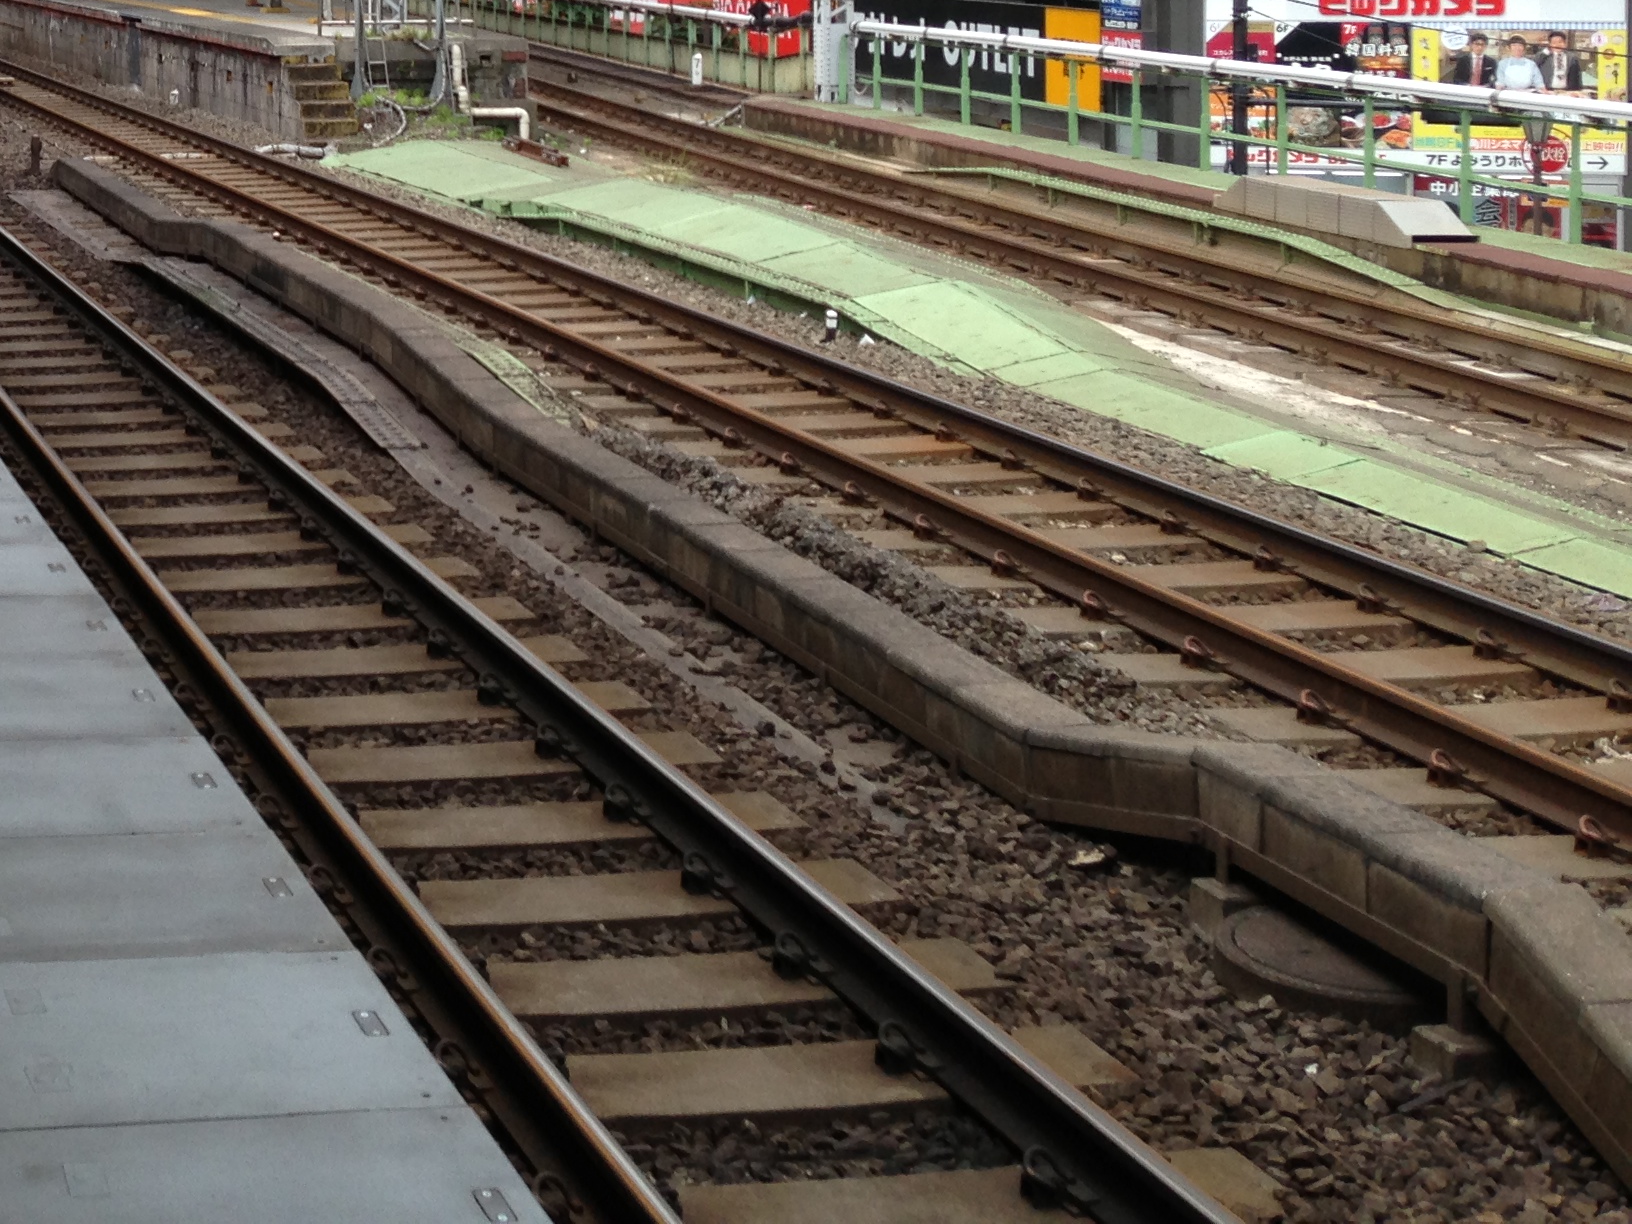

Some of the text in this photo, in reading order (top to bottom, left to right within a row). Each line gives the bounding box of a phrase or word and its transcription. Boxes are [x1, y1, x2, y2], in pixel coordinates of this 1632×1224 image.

[942, 20, 1040, 78] OUTLET
[1345, 43, 1409, 57] 韓国料理
[1426, 154, 1448, 166] 7F
